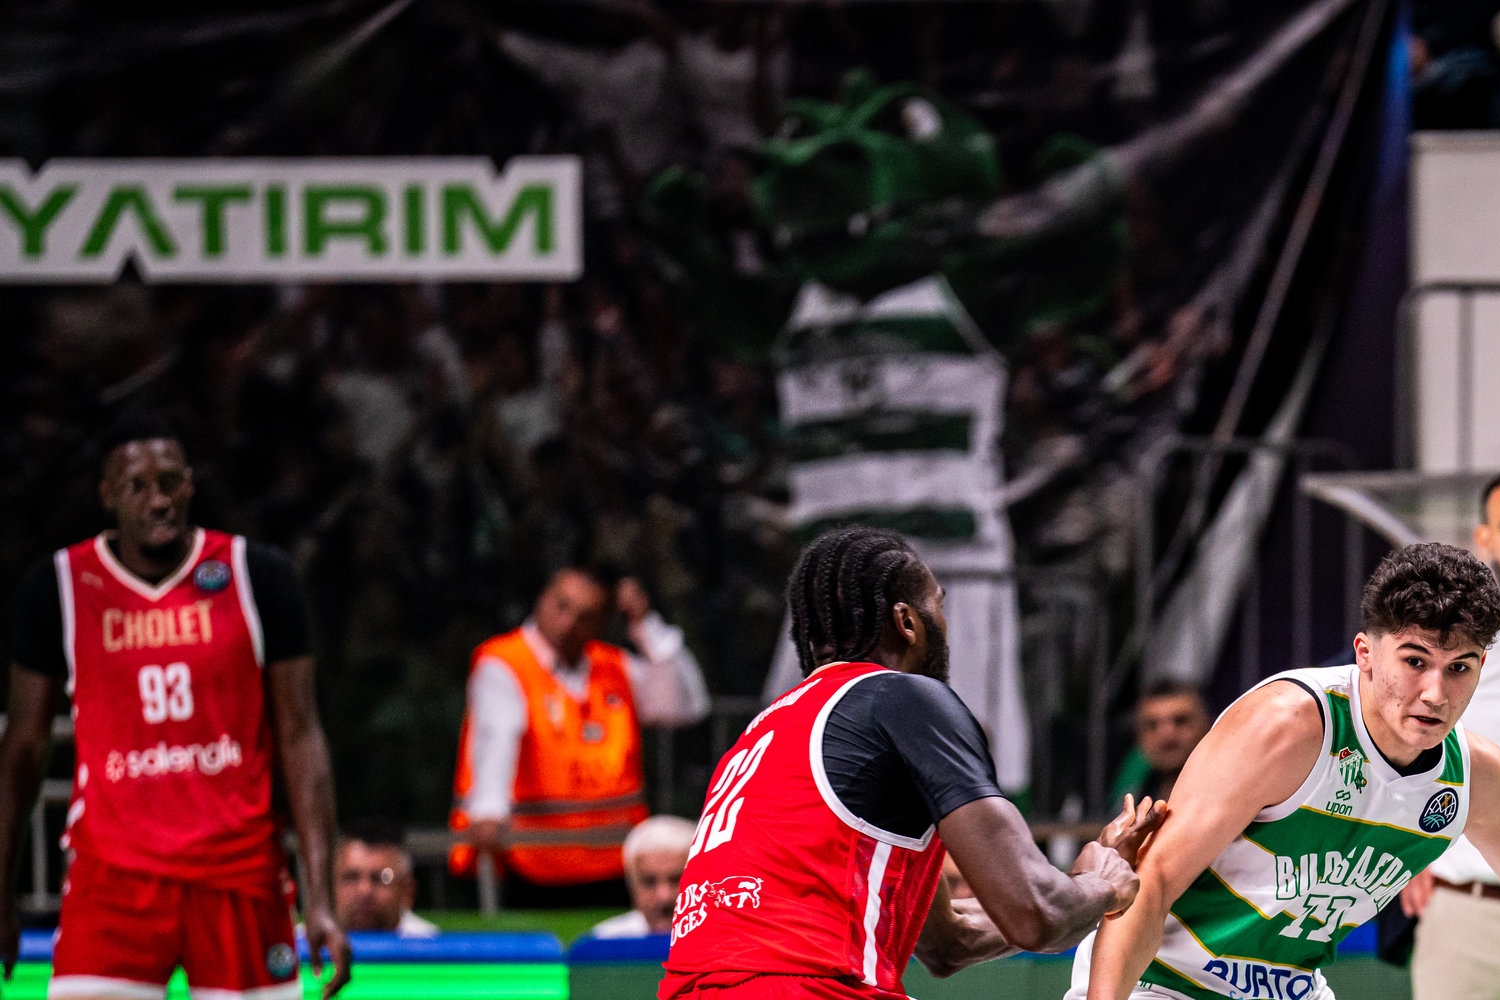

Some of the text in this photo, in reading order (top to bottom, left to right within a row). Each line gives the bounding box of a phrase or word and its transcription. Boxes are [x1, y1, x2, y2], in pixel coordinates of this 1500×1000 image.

[0, 183, 557, 259] YATIRIM
[103, 600, 212, 652] CHOLET
[138, 662, 195, 725] 93
[684, 730, 775, 868] 22
[1325, 800, 1353, 817] upon
[672, 879, 709, 924] URS
